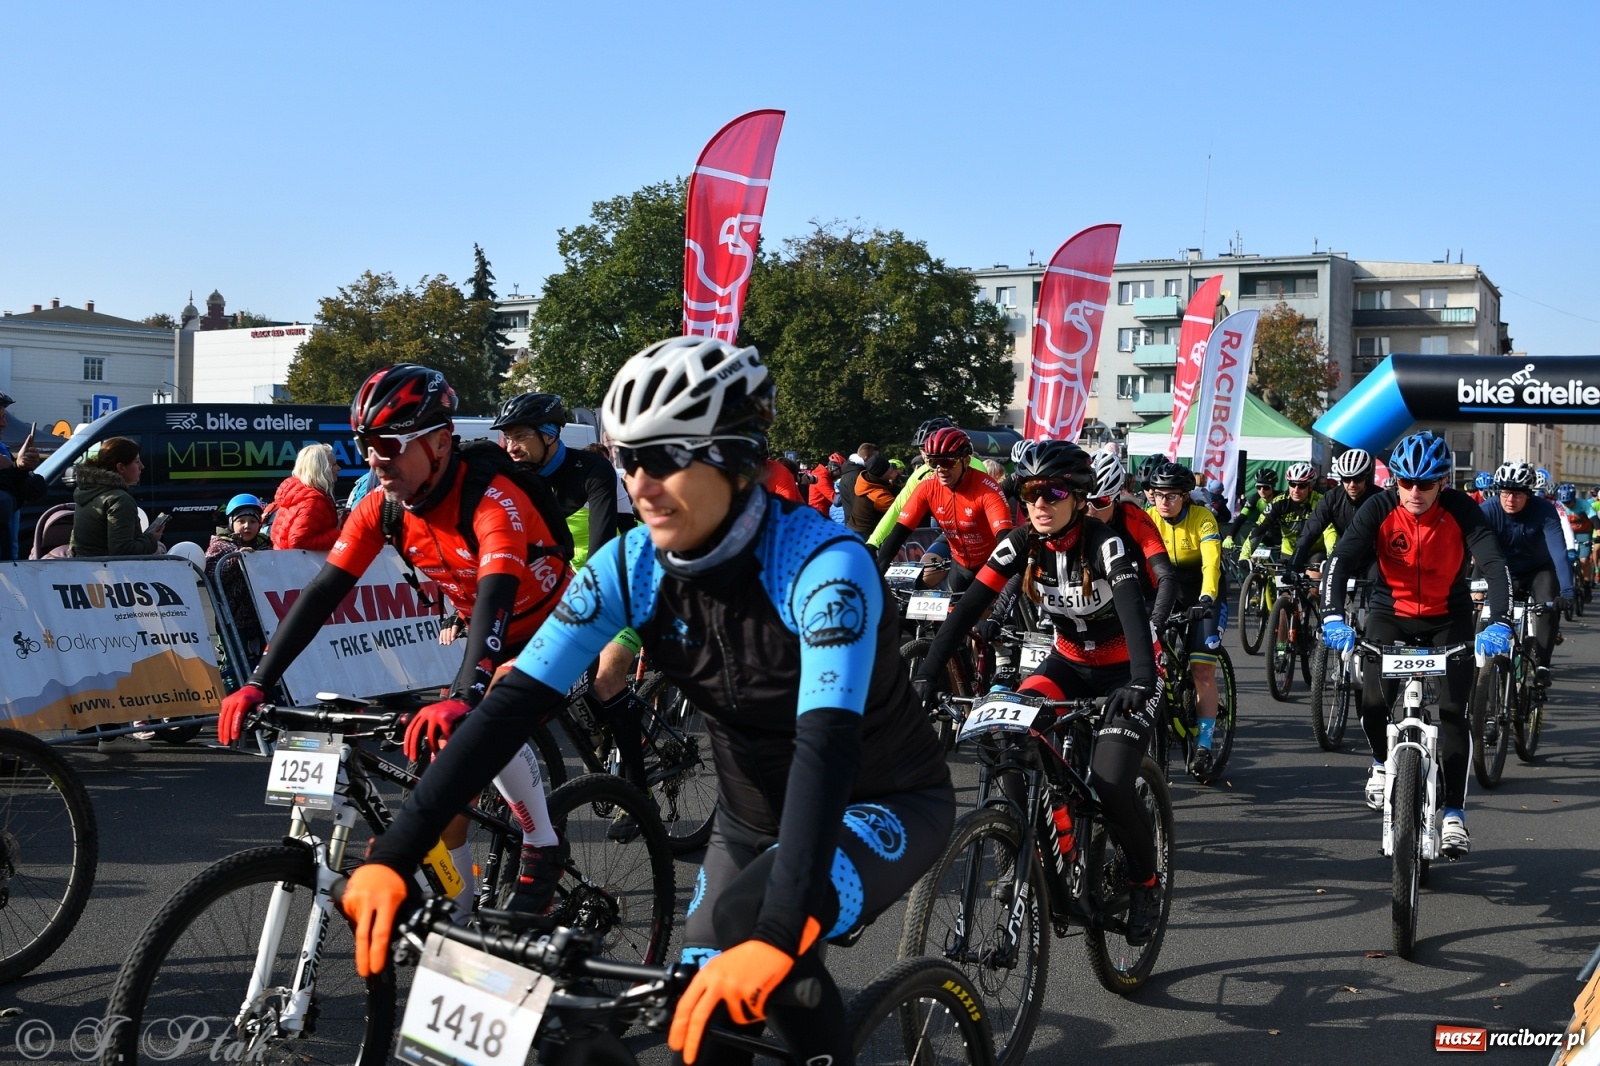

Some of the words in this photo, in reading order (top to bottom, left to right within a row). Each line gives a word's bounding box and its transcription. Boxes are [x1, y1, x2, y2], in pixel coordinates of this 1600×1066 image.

[717, 359, 744, 381] uvex
[1458, 378, 1515, 404] bike
[1522, 379, 1600, 406] atelie
[206, 412, 248, 431] bike
[253, 413, 313, 431] atelier
[167, 440, 364, 468] MTBMAAT
[172, 505, 218, 513] MERIDA
[483, 486, 503, 500] RA
[499, 497, 524, 532] BIKE
[52, 582, 154, 610] TAURUS
[264, 581, 447, 626] YKIMA
[915, 601, 943, 612] 1246
[114, 611, 159, 621] gdziekolwiek
[159, 610, 188, 620] jedziesz
[329, 633, 373, 659] TAKE
[371, 624, 417, 651] MORE
[1030, 649, 1049, 663] 13
[1393, 659, 1435, 670] 2898
[974, 707, 1021, 725] 1211
[280, 759, 324, 784] 1254
[941, 980, 981, 1021] MAXXIS
[426, 995, 508, 1058] 1418
